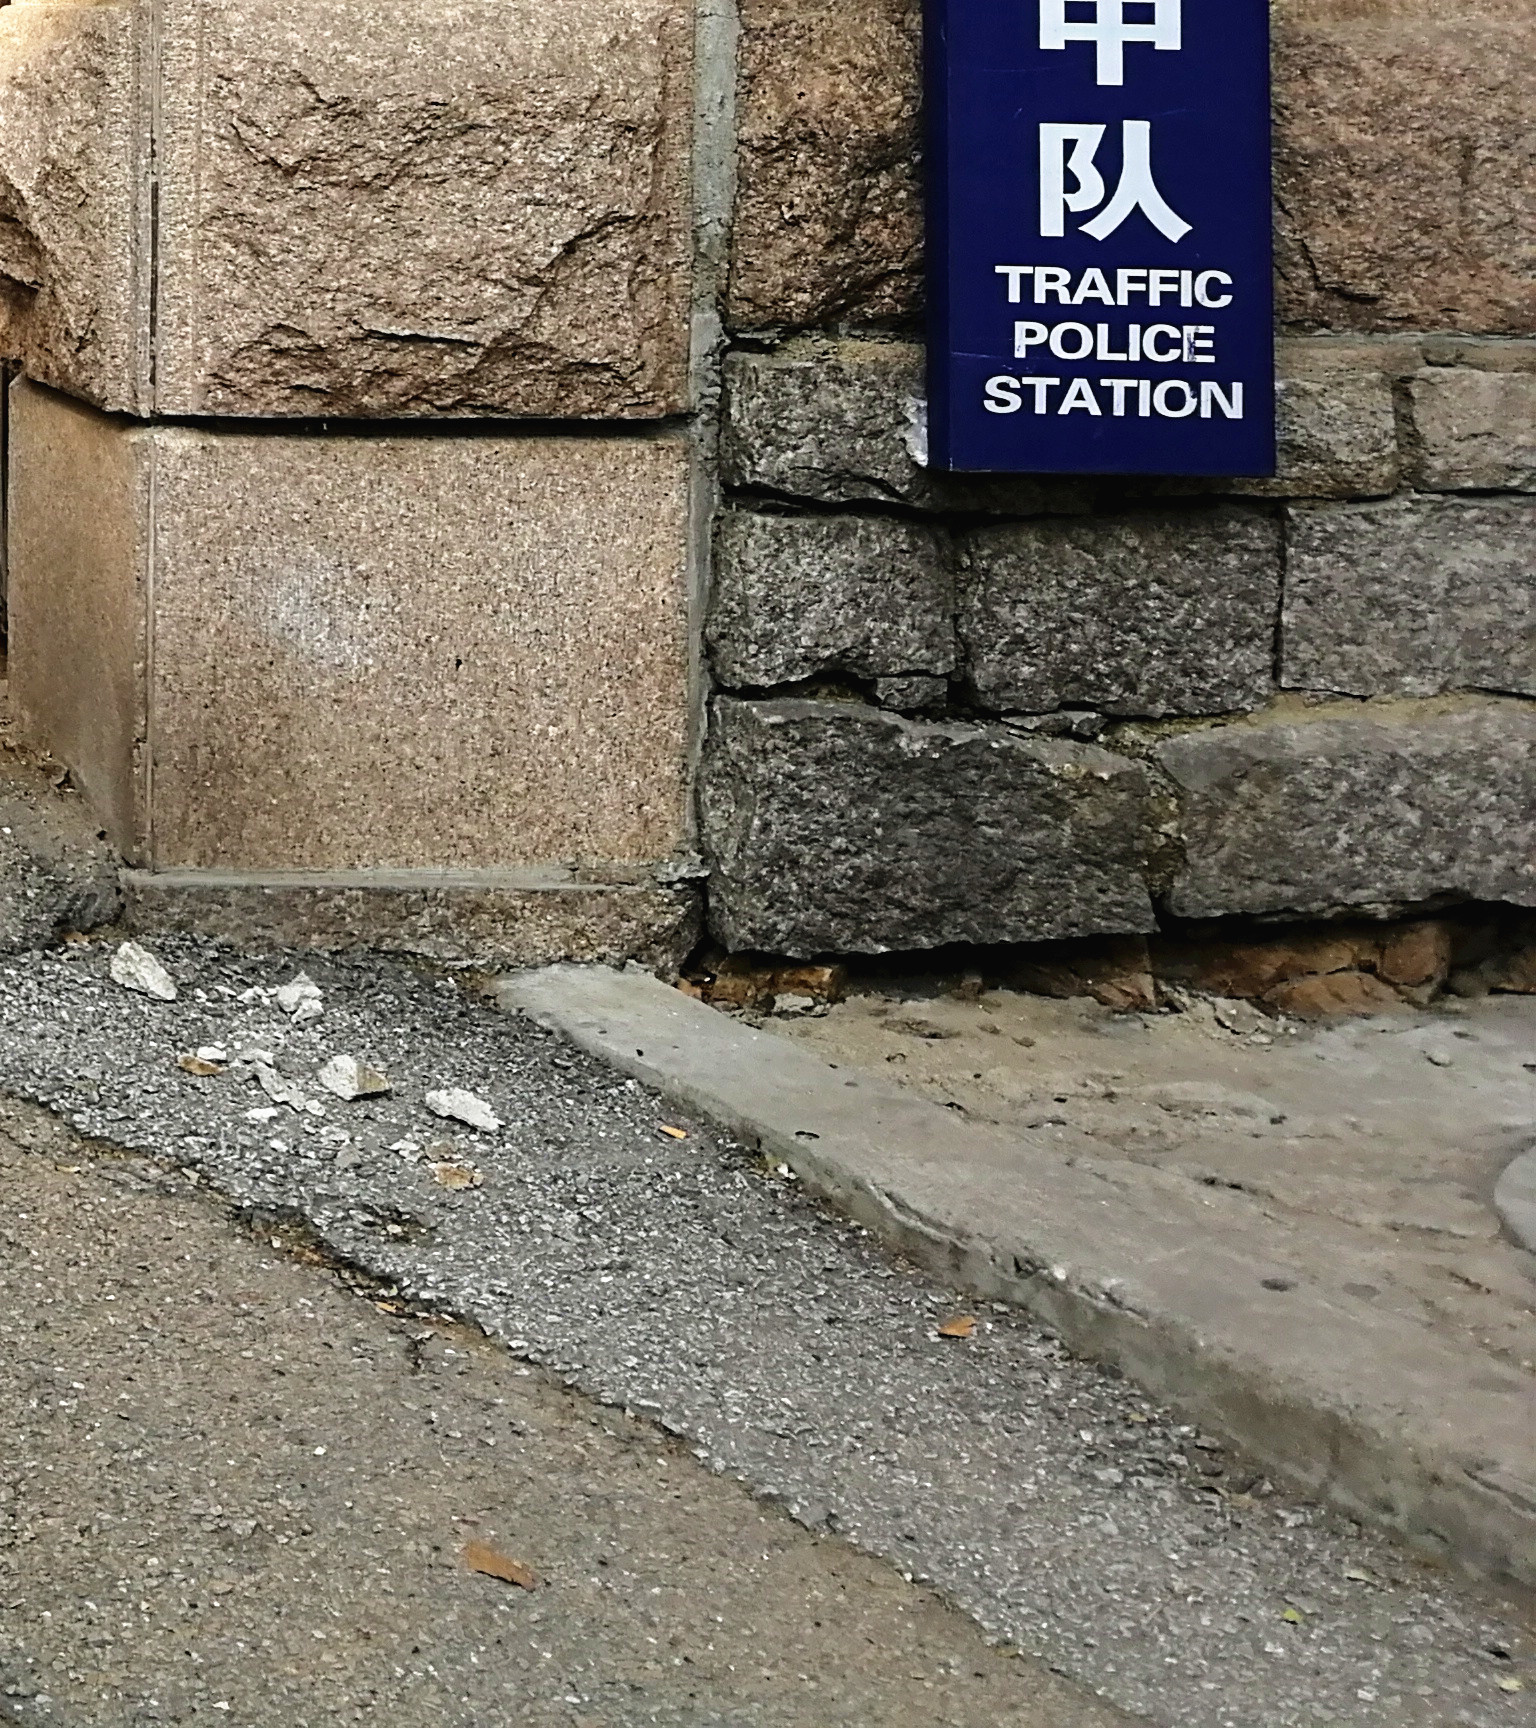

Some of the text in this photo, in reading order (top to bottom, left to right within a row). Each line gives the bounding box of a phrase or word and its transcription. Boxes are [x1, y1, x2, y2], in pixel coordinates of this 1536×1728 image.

[994, 265, 1233, 309] TRAFFIC
[1013, 321, 1216, 363] POLICE
[983, 375, 1244, 419] STATION
